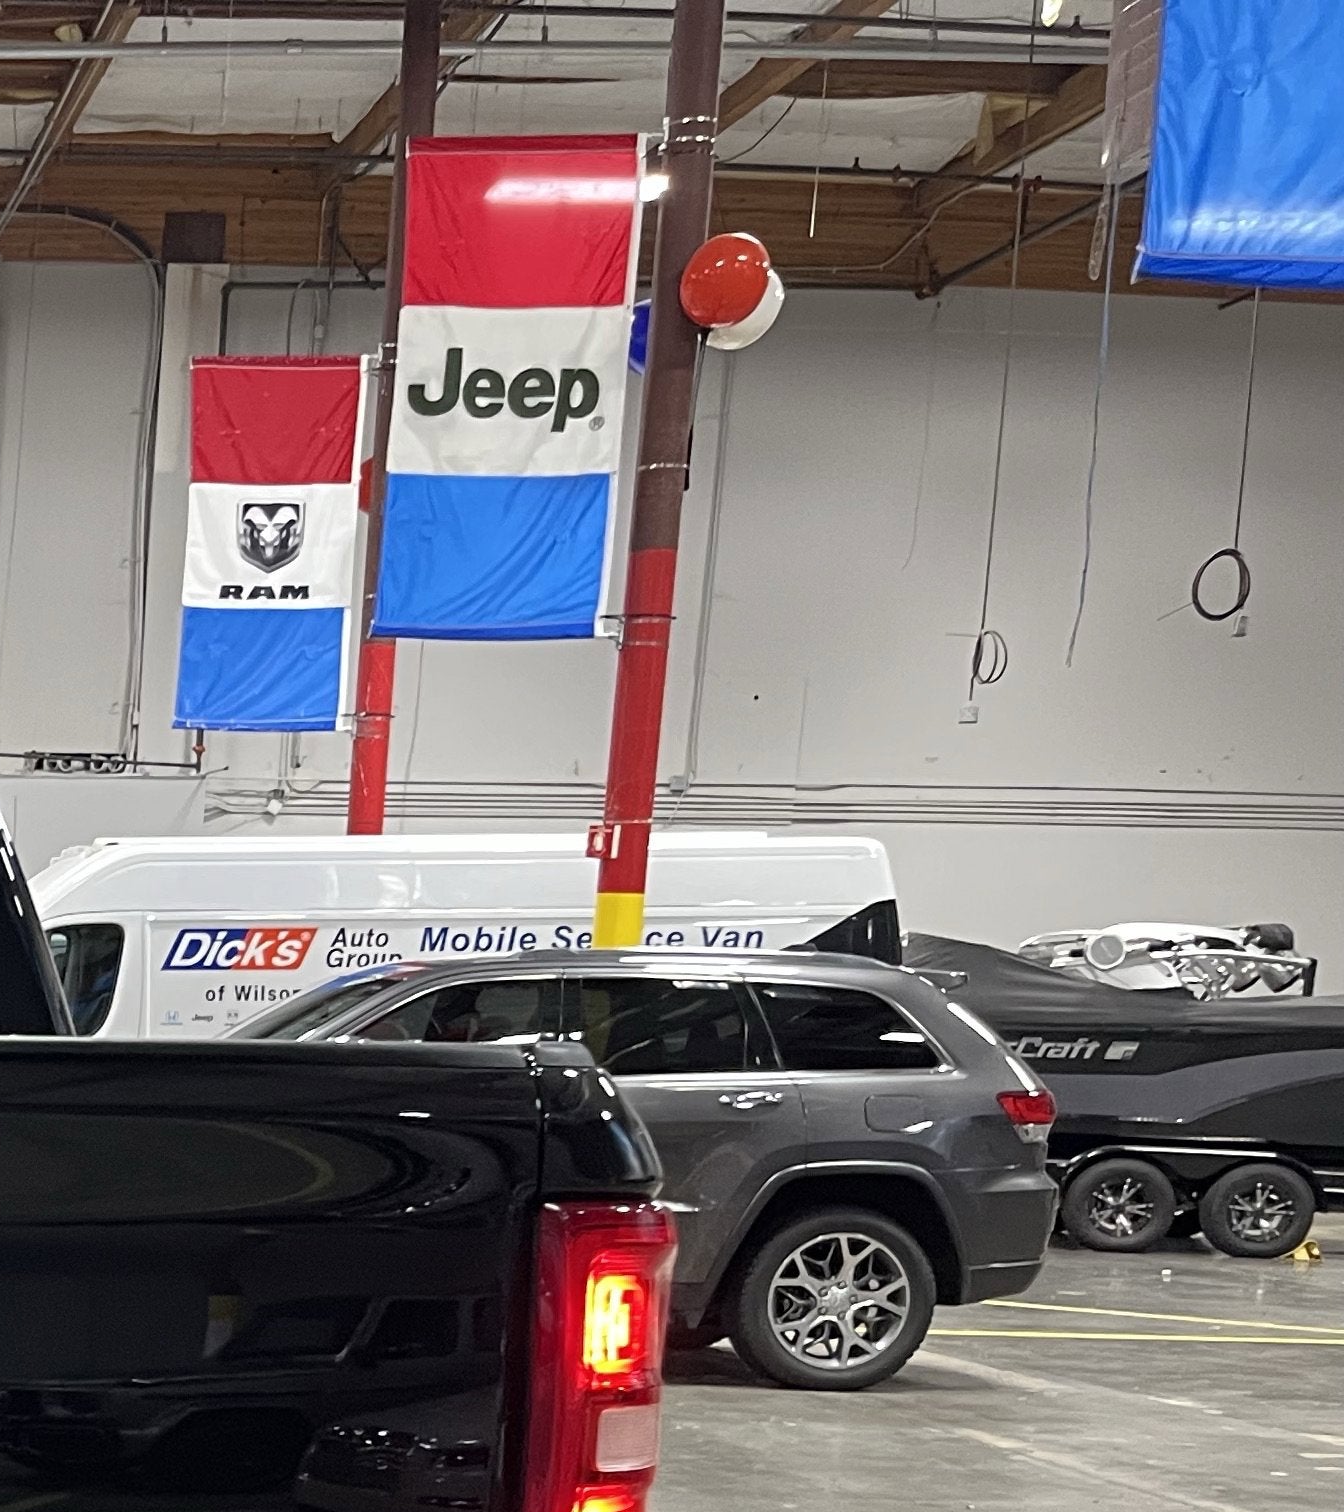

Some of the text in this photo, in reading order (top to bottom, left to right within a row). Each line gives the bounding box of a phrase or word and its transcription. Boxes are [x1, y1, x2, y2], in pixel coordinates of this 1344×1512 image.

[407, 347, 600, 432] Jeep
[218, 584, 310, 600] RAM
[169, 929, 305, 968] Dick's
[330, 927, 390, 948] Auto
[419, 925, 763, 953] Mobile Sece Van
[205, 985, 226, 1002] of
